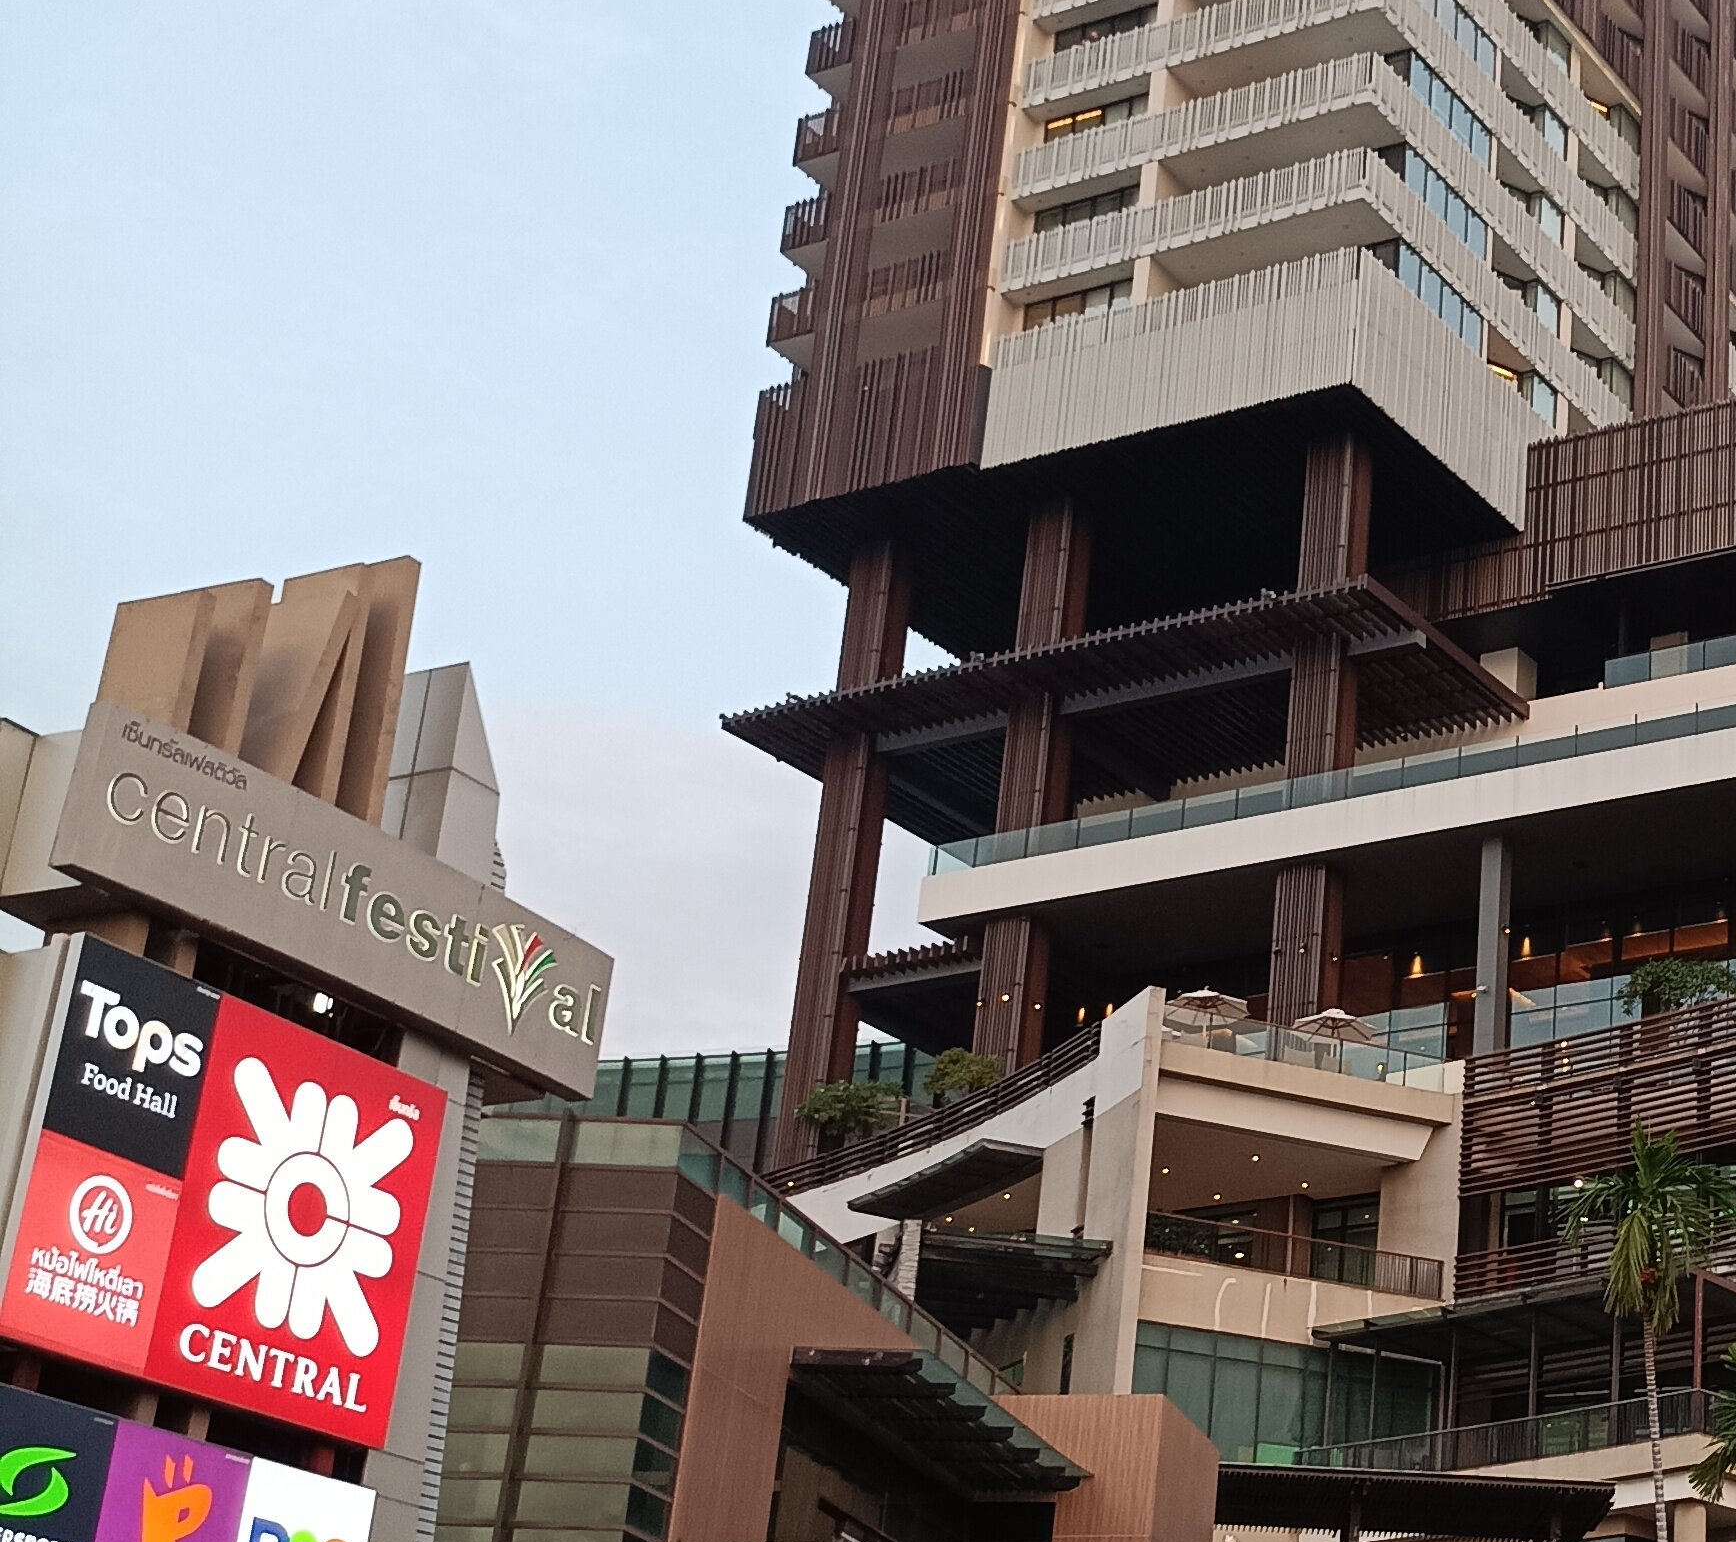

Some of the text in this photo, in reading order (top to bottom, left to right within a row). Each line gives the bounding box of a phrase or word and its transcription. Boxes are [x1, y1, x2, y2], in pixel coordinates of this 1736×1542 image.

[81, 979, 204, 1078] Tops
[81, 1062, 178, 1119] Food Hall
[178, 1323, 368, 1413] CENTRAL
